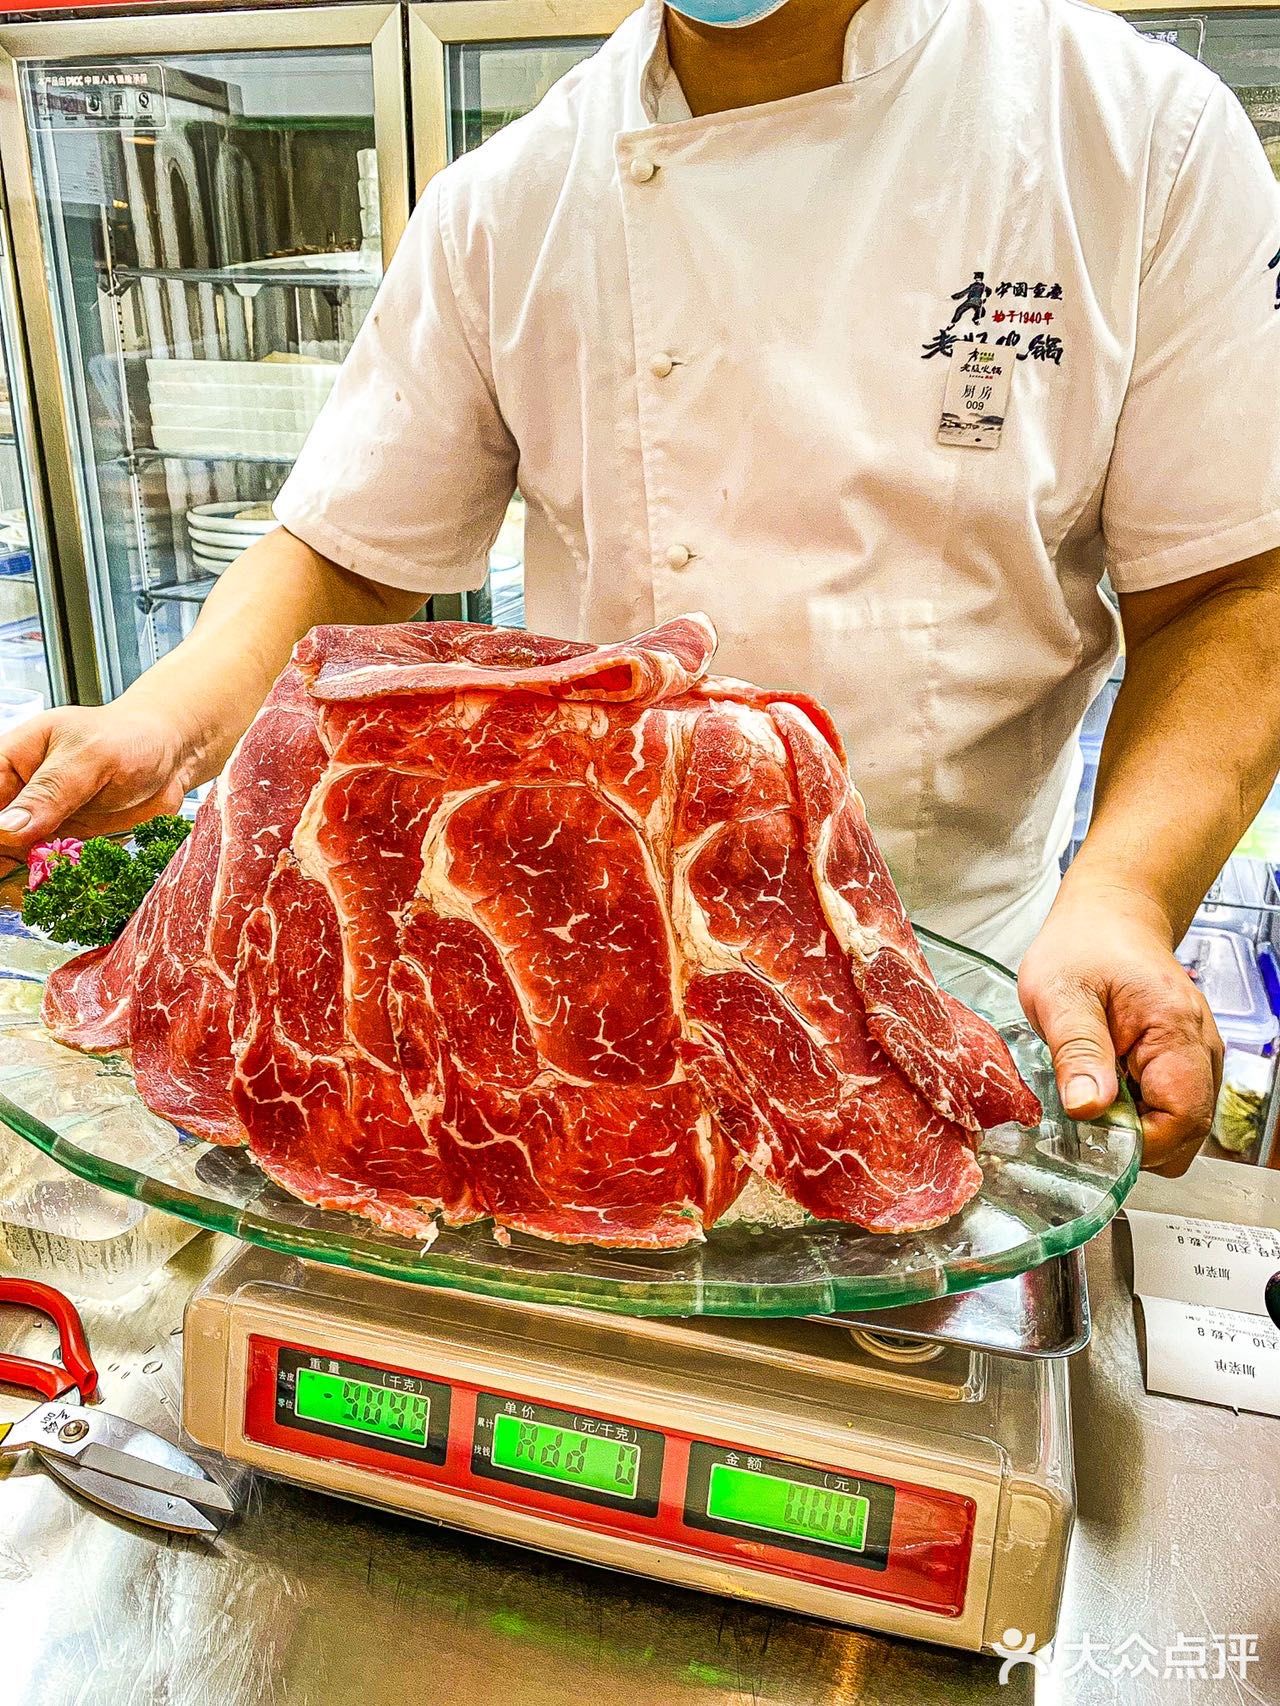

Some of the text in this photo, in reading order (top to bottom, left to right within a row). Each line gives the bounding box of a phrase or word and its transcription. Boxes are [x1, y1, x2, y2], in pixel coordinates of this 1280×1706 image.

[961, 384, 993, 400] 厨房
[965, 400, 985, 411] 009
[309, 1356, 341, 1375] 重量
[278, 1370, 295, 1383] 去皮
[277, 1397, 294, 1411] 零位
[504, 1401, 536, 1421] 单价
[477, 1416, 494, 1430] 累计
[725, 1452, 862, 1494] 金额 (元)
